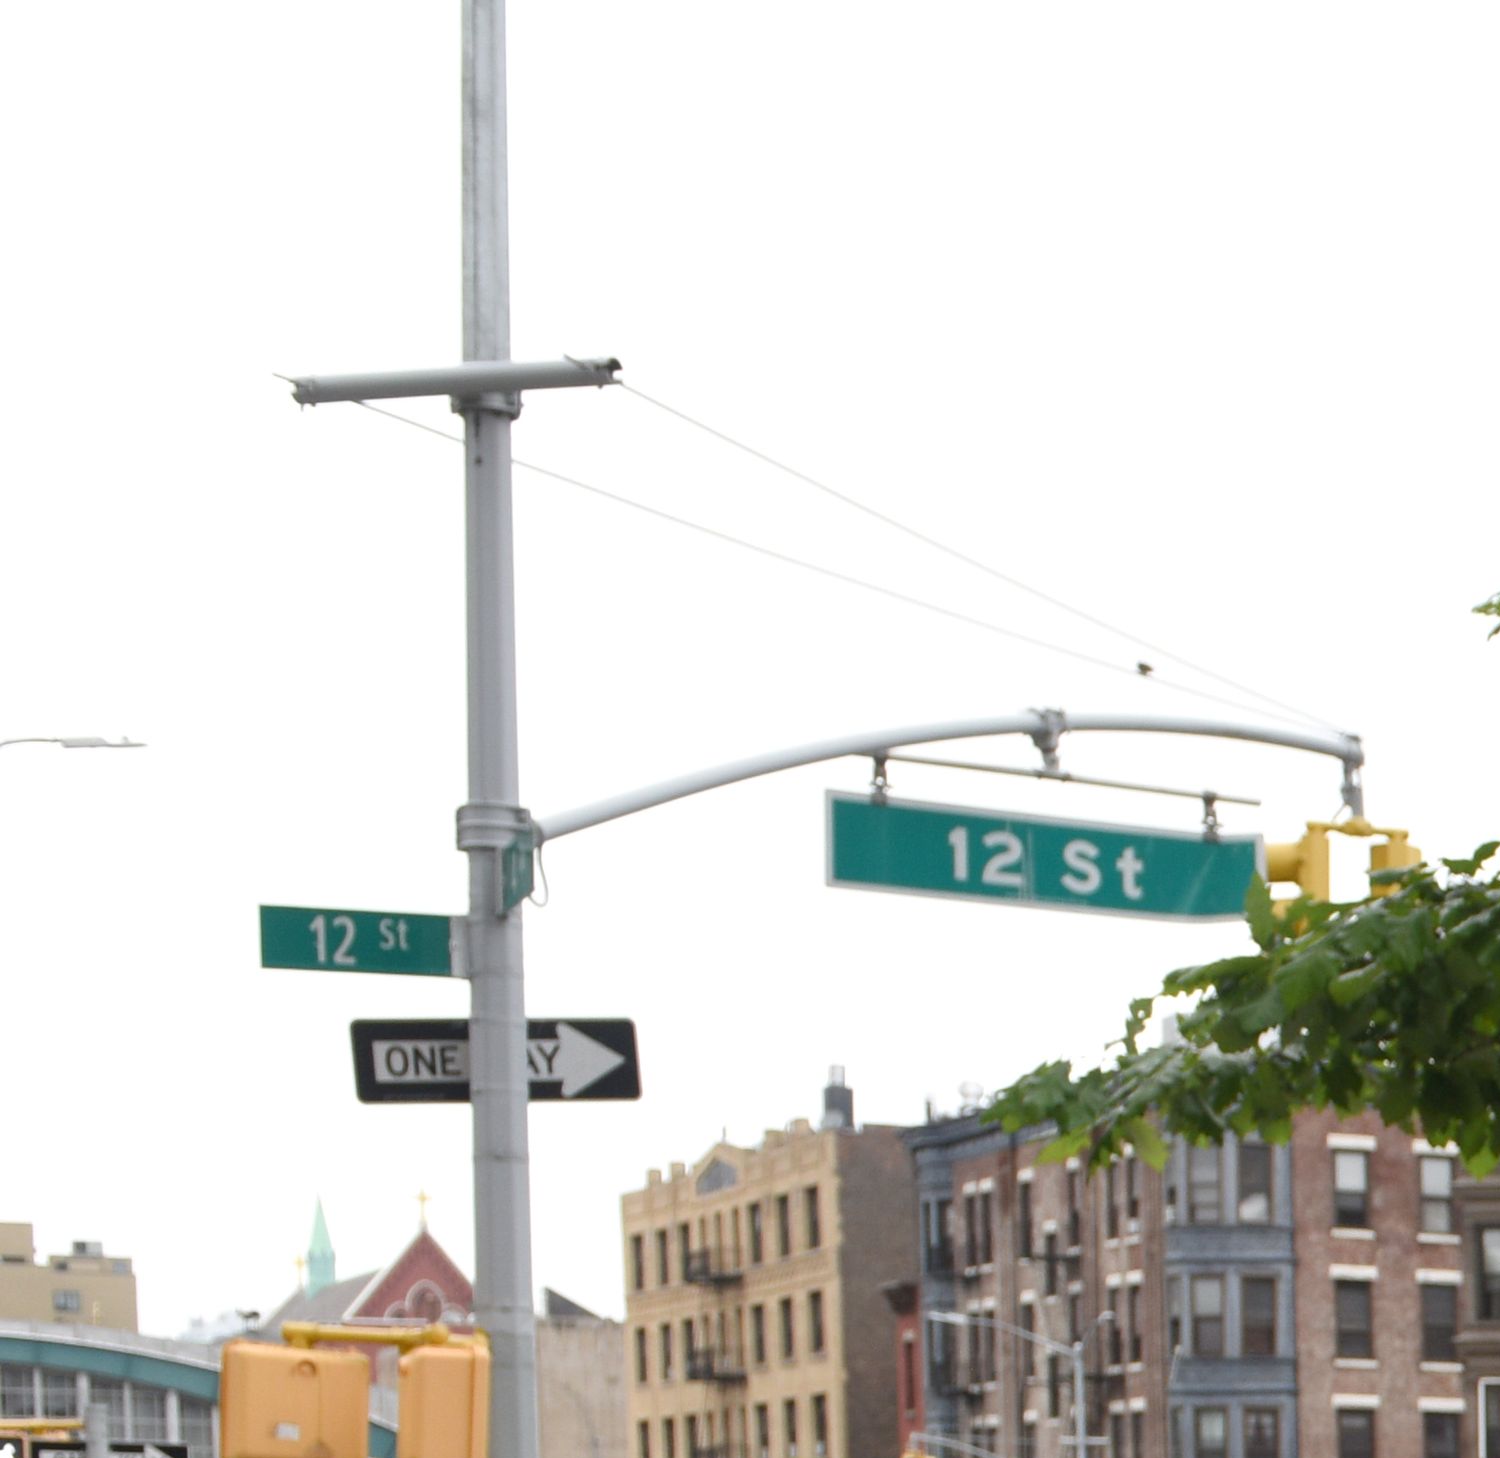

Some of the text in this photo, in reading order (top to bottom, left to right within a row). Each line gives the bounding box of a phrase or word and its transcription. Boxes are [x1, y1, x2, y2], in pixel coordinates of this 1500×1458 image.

[948, 826, 1144, 900] 12 St
[309, 914, 409, 965] 12 St
[384, 1045, 561, 1077] ONE AY
